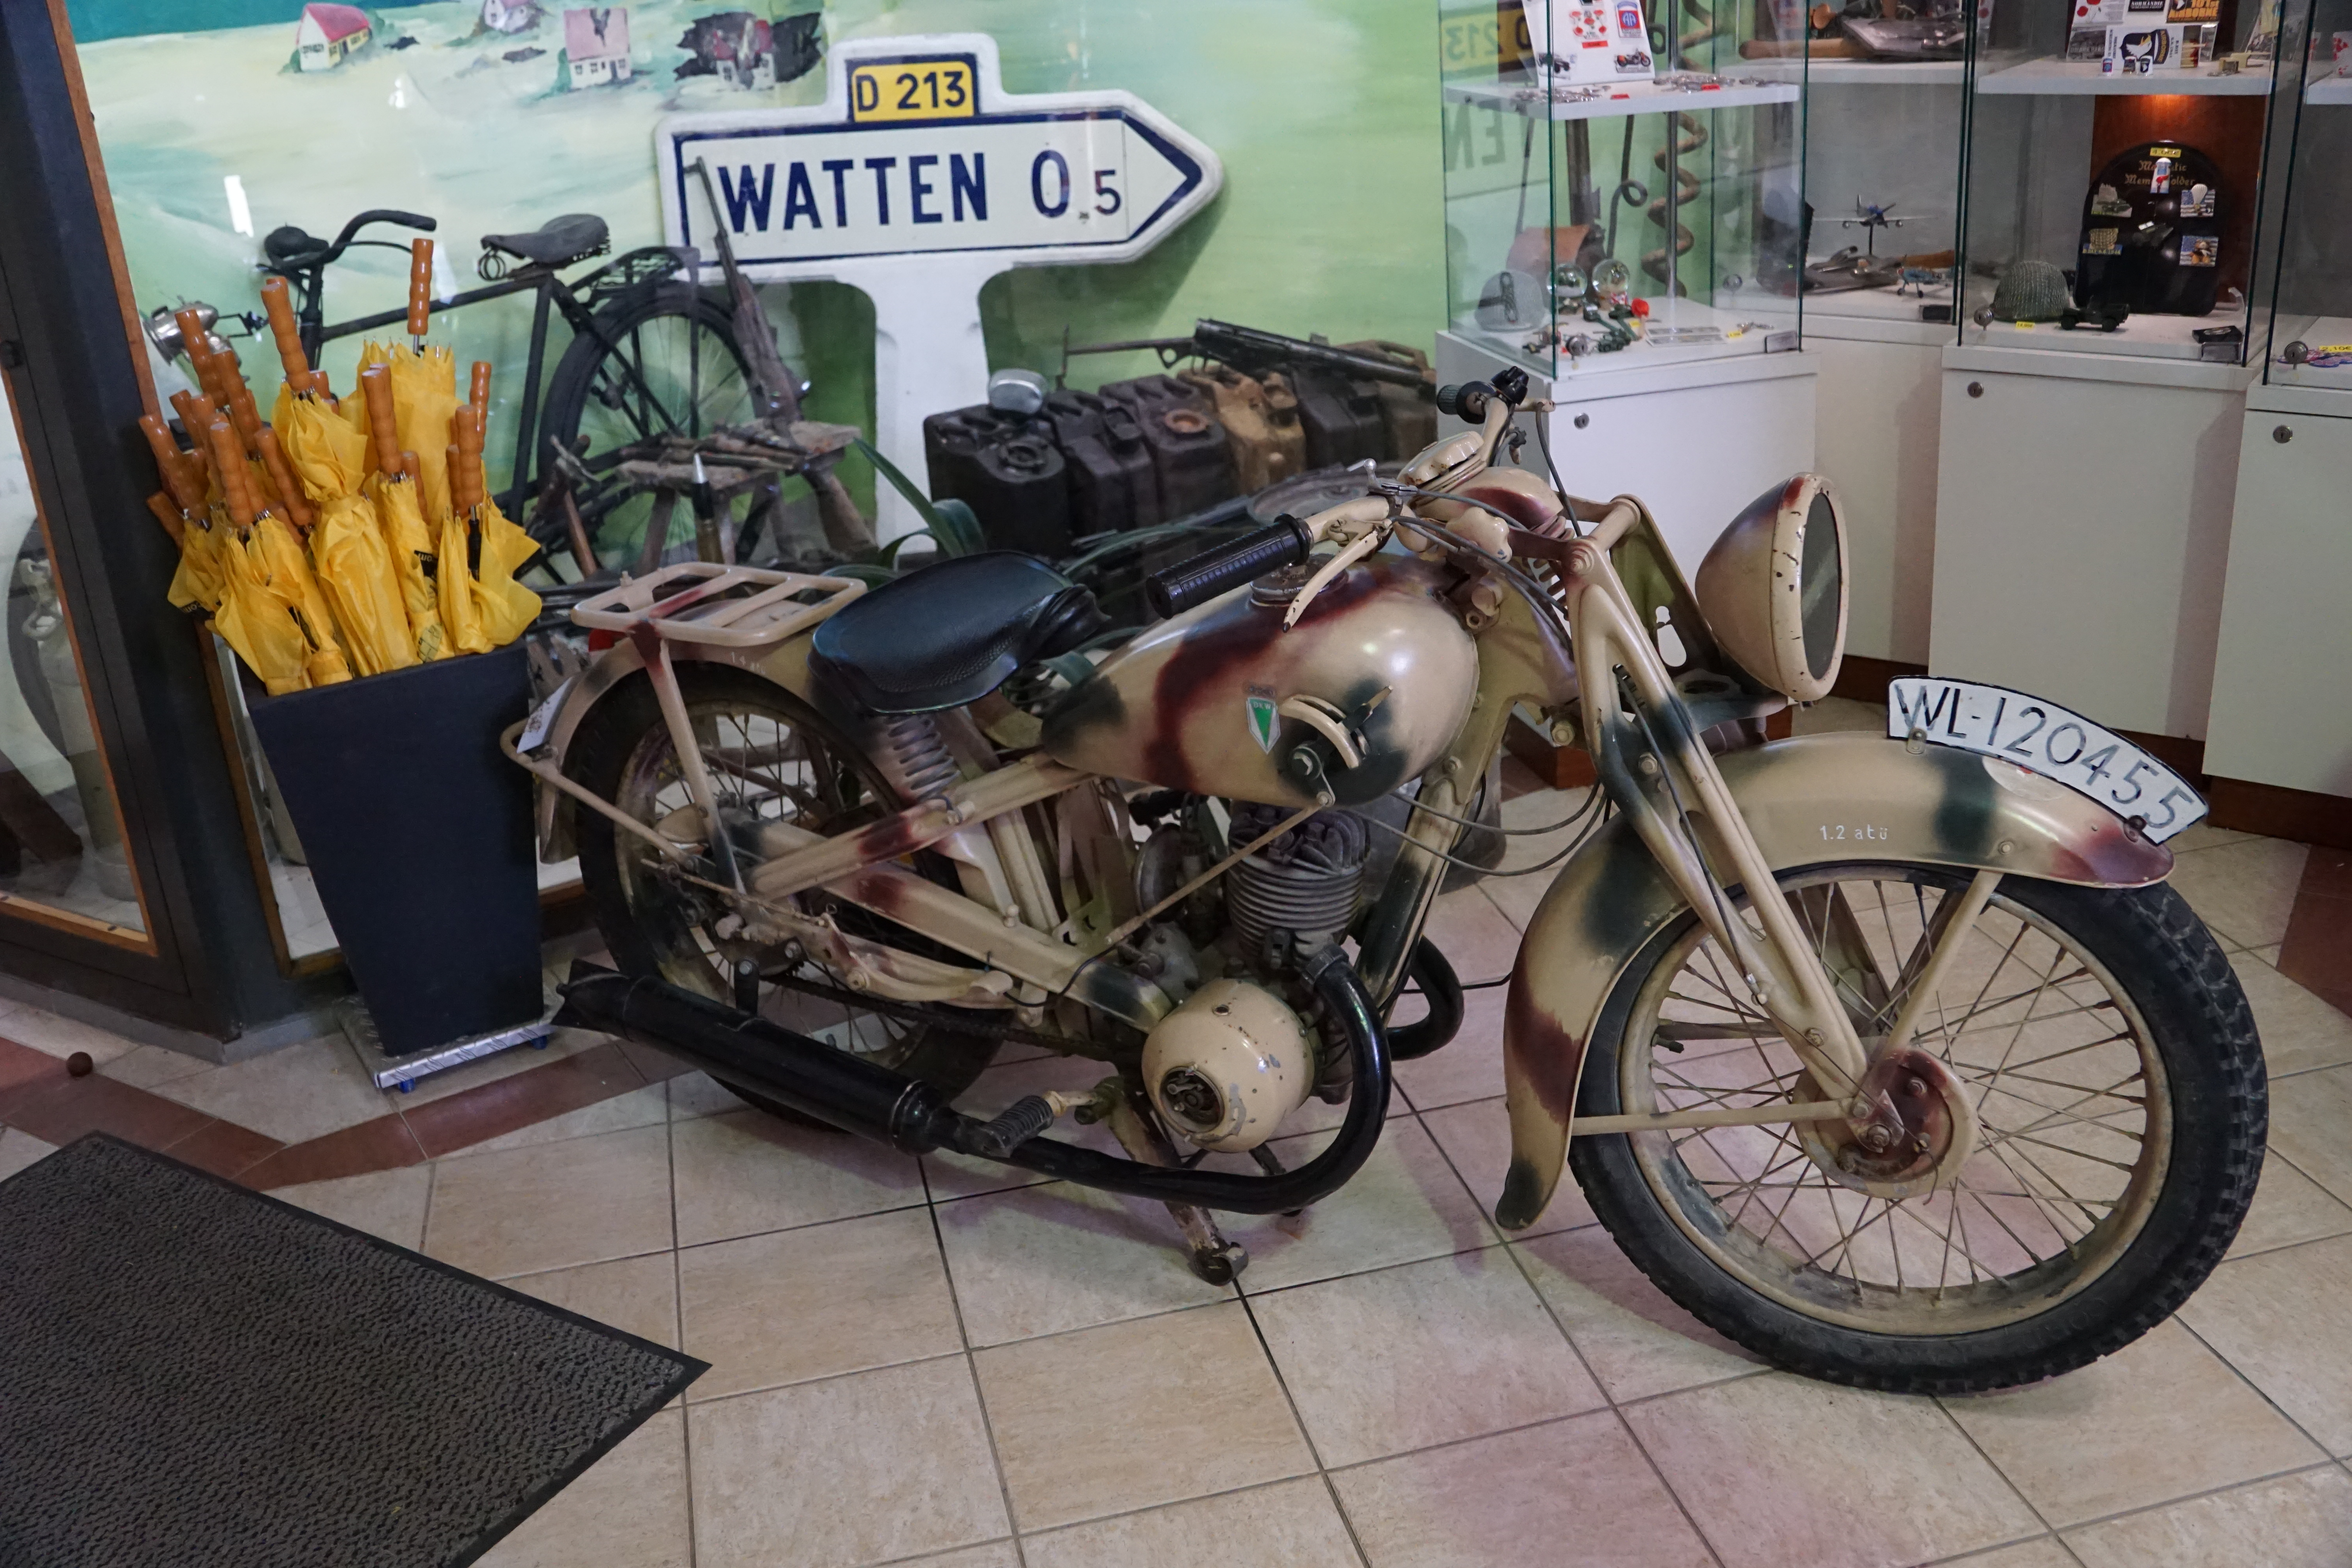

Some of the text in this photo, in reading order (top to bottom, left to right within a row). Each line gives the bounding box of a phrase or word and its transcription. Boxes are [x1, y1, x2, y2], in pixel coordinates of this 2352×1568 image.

[2168, 8, 2218, 18] AIRBORNE
[2158, 31, 2167, 62] AIRBORNE
[856, 71, 965, 112] D 213
[717, 152, 988, 233] WATTEN
[1894, 683, 2196, 829] WL-120455
[1819, 824, 1888, 840] 1.2 atü
